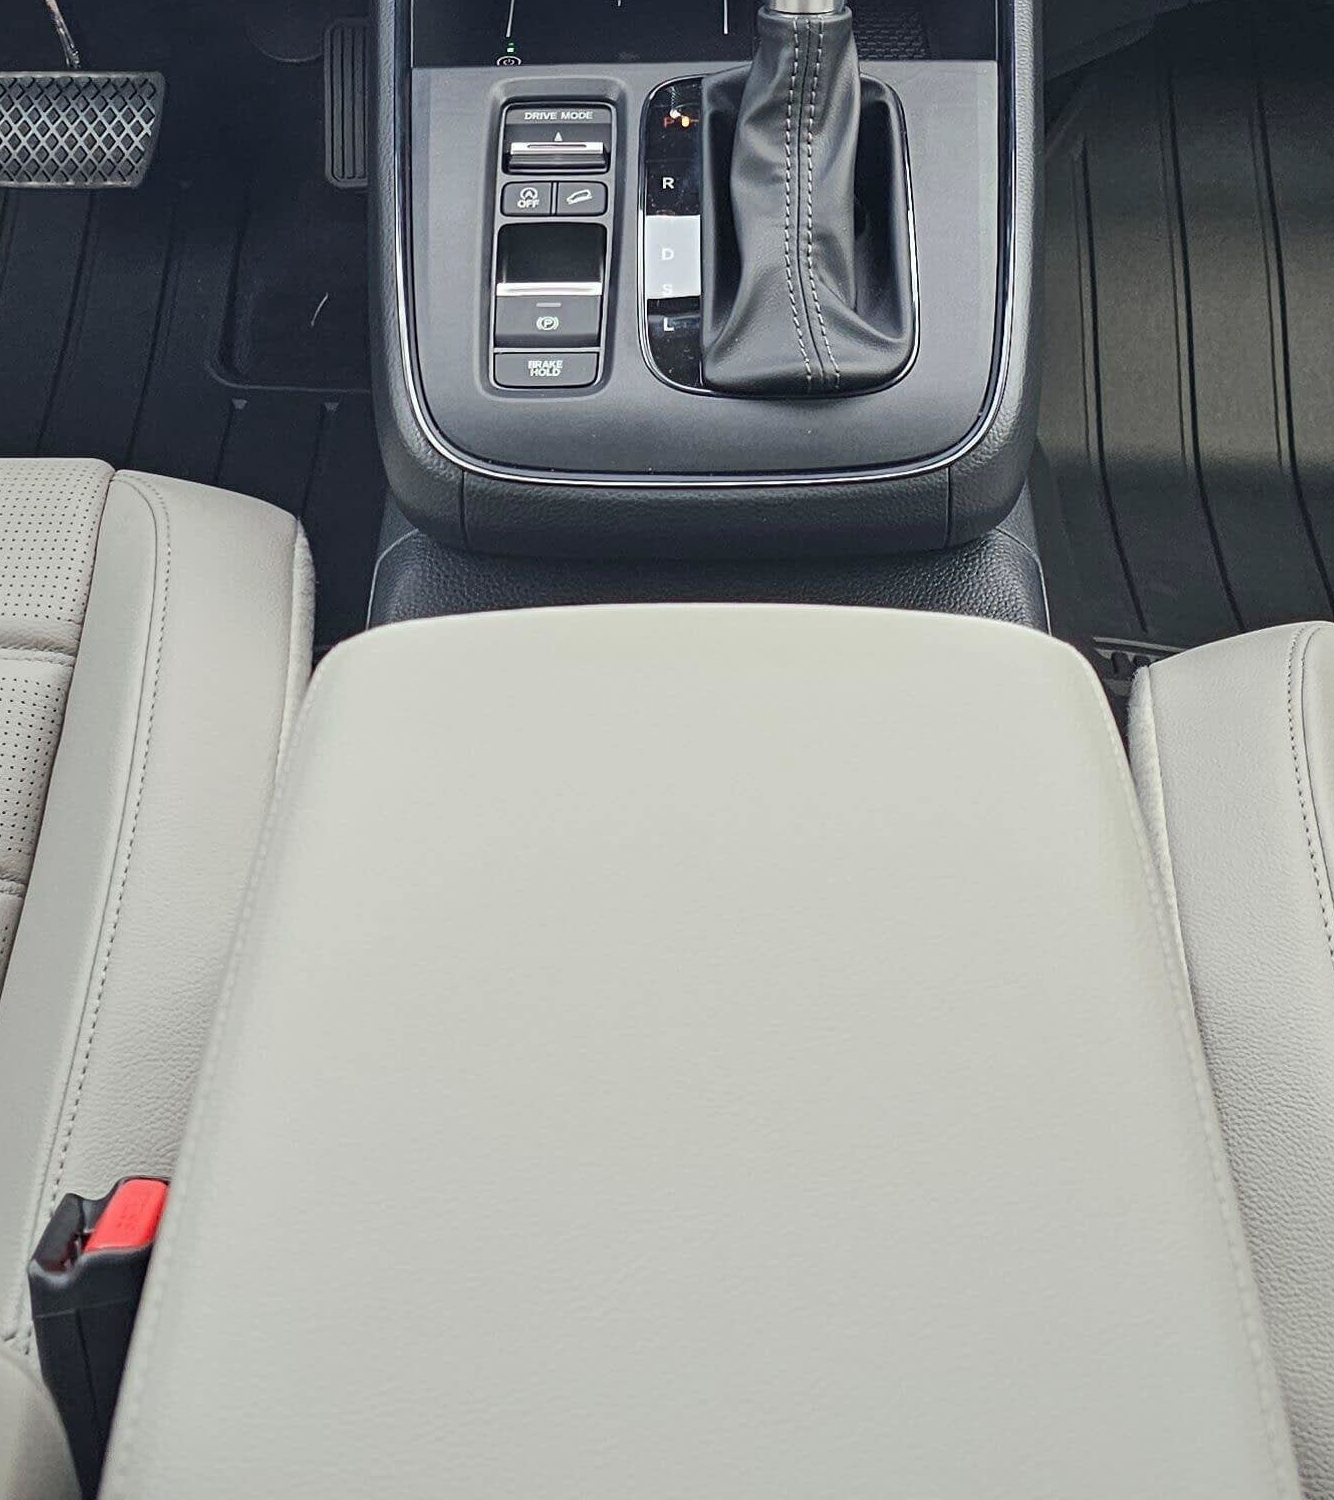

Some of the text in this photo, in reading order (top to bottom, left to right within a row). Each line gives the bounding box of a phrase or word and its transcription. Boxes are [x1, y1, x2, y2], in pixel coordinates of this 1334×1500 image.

[524, 111, 593, 120] DRIVE MODE
[662, 177, 675, 189] R
[517, 199, 539, 208] OFF
[662, 248, 674, 261] D
[662, 284, 673, 295] S
[663, 318, 674, 332] L
[528, 360, 563, 369] BRAKE
[530, 368, 561, 377] HOLD
